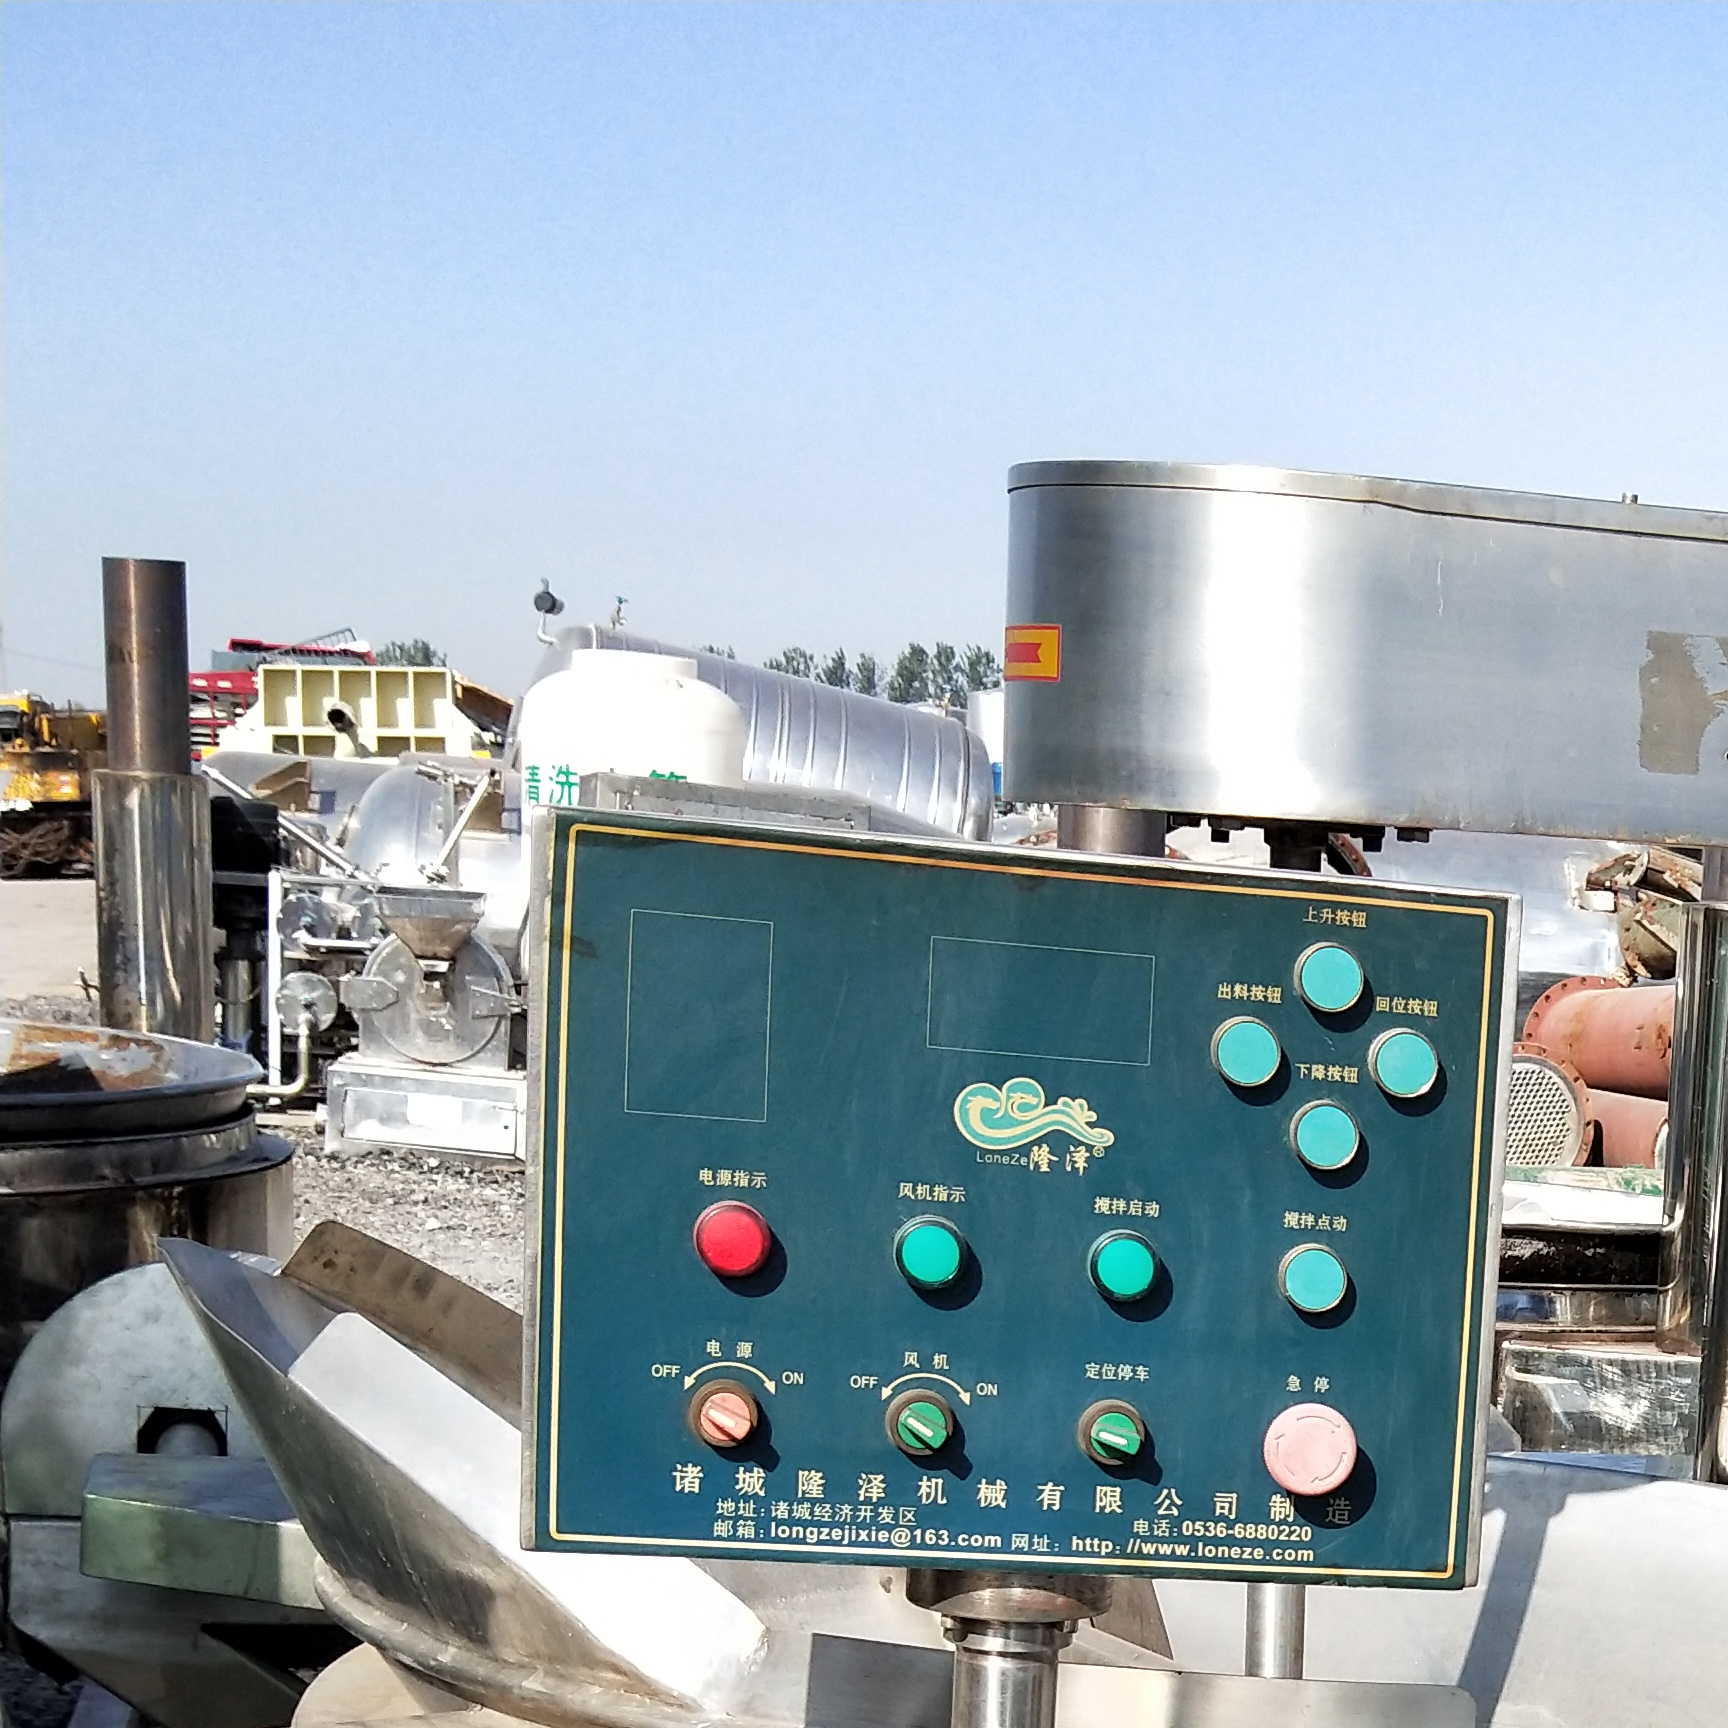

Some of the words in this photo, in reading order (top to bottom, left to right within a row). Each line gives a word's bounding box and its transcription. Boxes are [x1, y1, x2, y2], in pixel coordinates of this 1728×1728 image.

[1302, 906, 1367, 928] 上升按钮
[1217, 981, 1282, 1004] 出料按钮
[1375, 996, 1438, 1017] 回位按钮
[1295, 1063, 1359, 1084] 下降按钮
[699, 1168, 767, 1189] 电源指示
[897, 1181, 966, 1203] 风机指示
[1094, 1196, 1160, 1218] 搅拌启动
[1283, 1211, 1347, 1232] 搅拌点动
[706, 1340, 754, 1359] 电源
[651, 1364, 681, 1378] OFF
[903, 1352, 950, 1370] 风机
[782, 1371, 804, 1385] ON
[1084, 1362, 1150, 1382] 定位停车
[850, 1376, 879, 1389] OFF
[976, 1383, 998, 1396] ON
[1285, 1375, 1330, 1393] 急停
